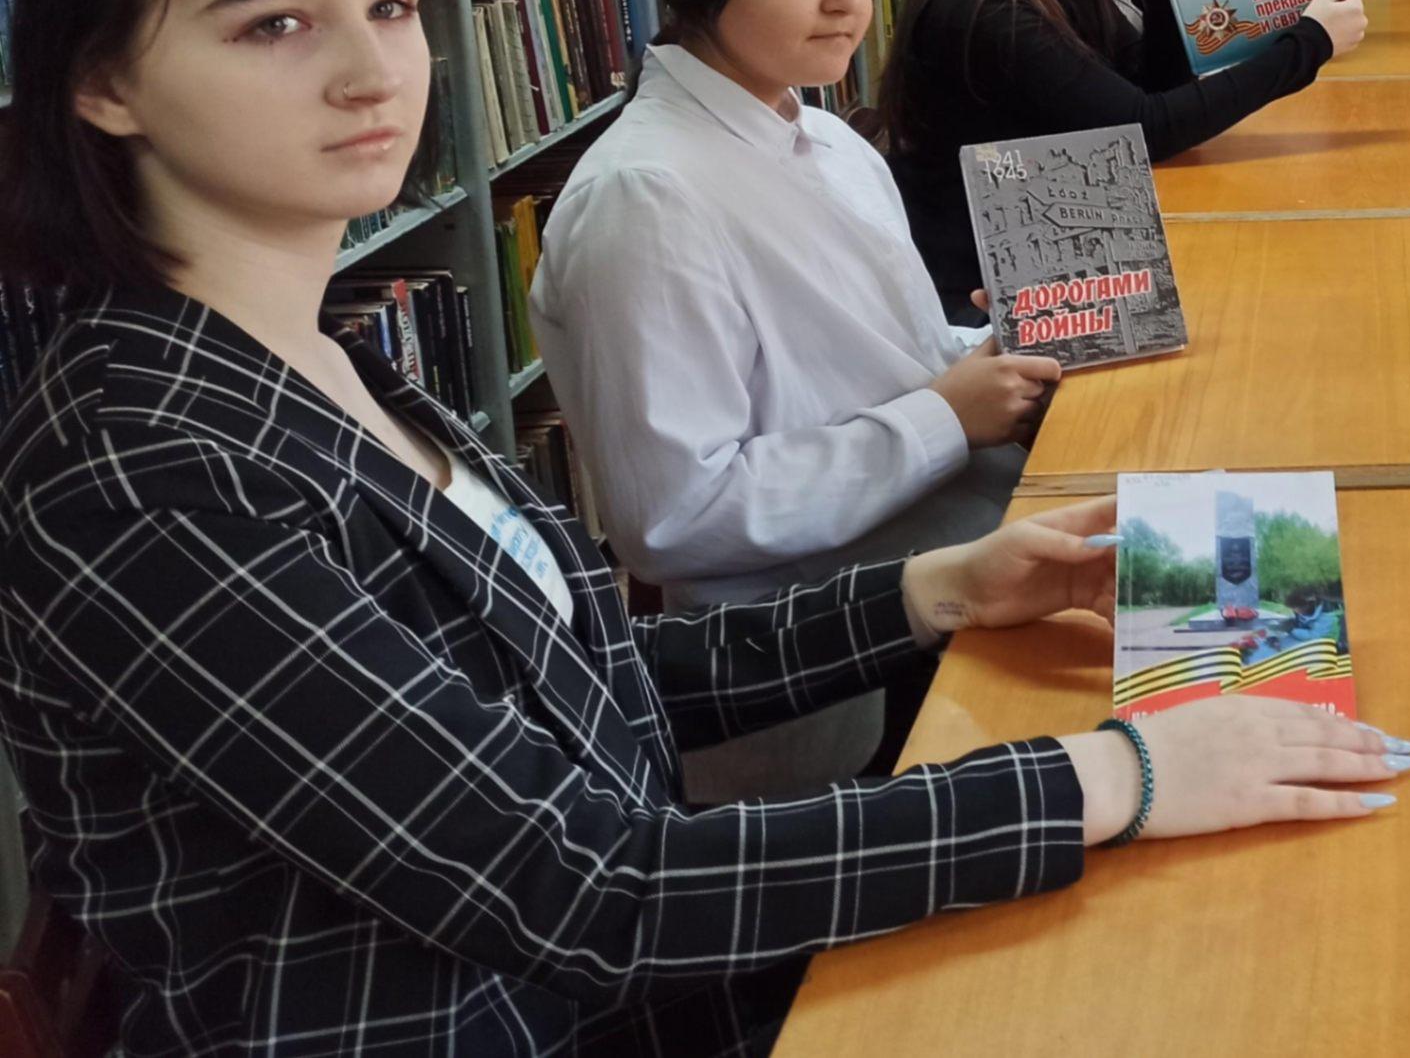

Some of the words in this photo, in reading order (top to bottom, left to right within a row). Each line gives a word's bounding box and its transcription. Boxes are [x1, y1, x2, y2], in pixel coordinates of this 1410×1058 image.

[985, 163, 1028, 183] 1945
[1059, 207, 1103, 221] BERLIN
[1013, 269, 1151, 317] ДОРОГАМИ
[1018, 306, 1113, 346] ВОЙНЫ
